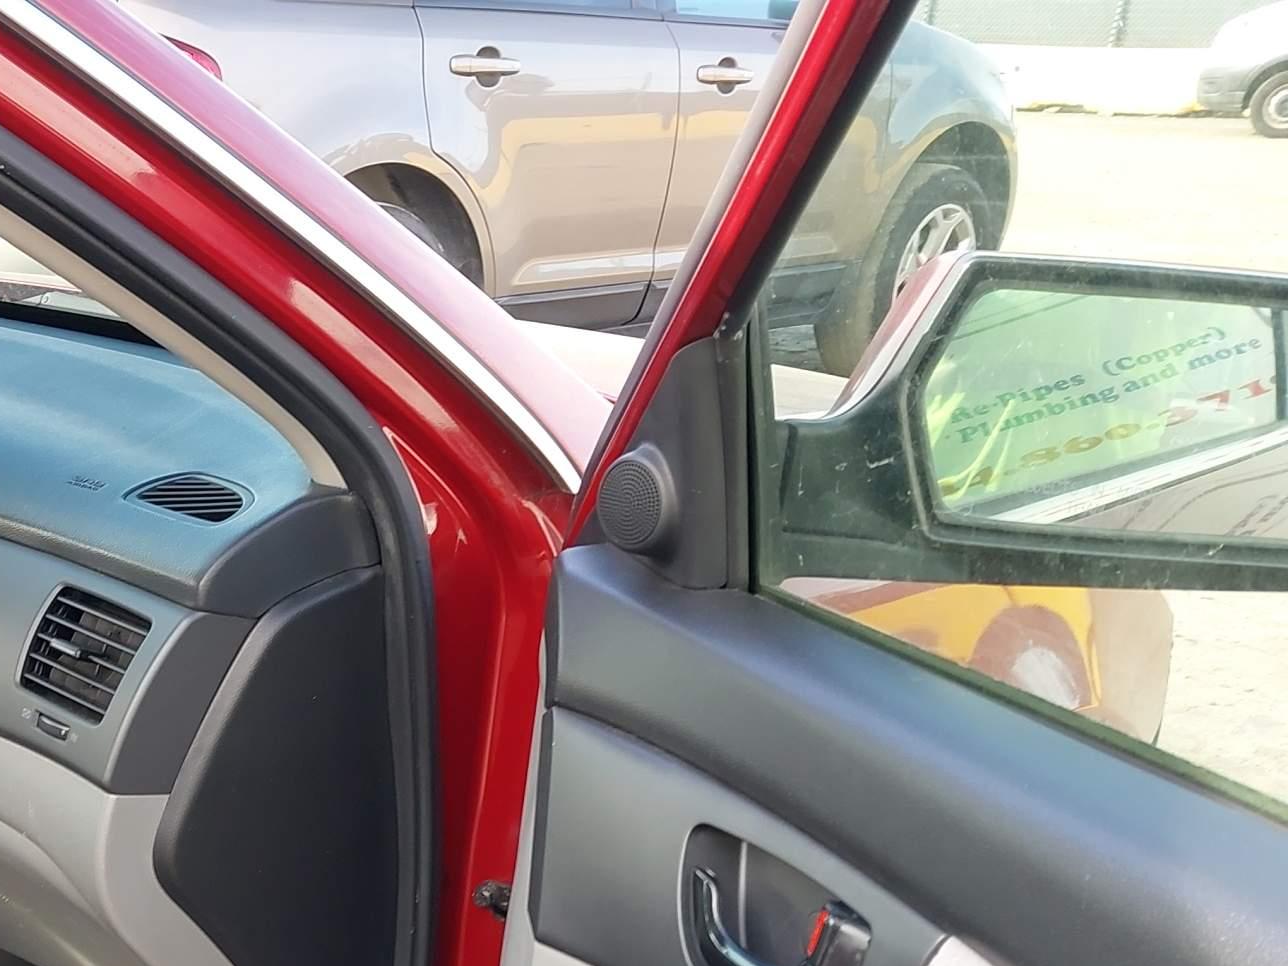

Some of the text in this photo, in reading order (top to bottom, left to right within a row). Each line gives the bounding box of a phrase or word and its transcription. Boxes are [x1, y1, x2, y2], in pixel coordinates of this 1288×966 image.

[1102, 326, 1226, 376] (Copper)
[1122, 363, 1180, 394] and
[1188, 337, 1262, 370] more
